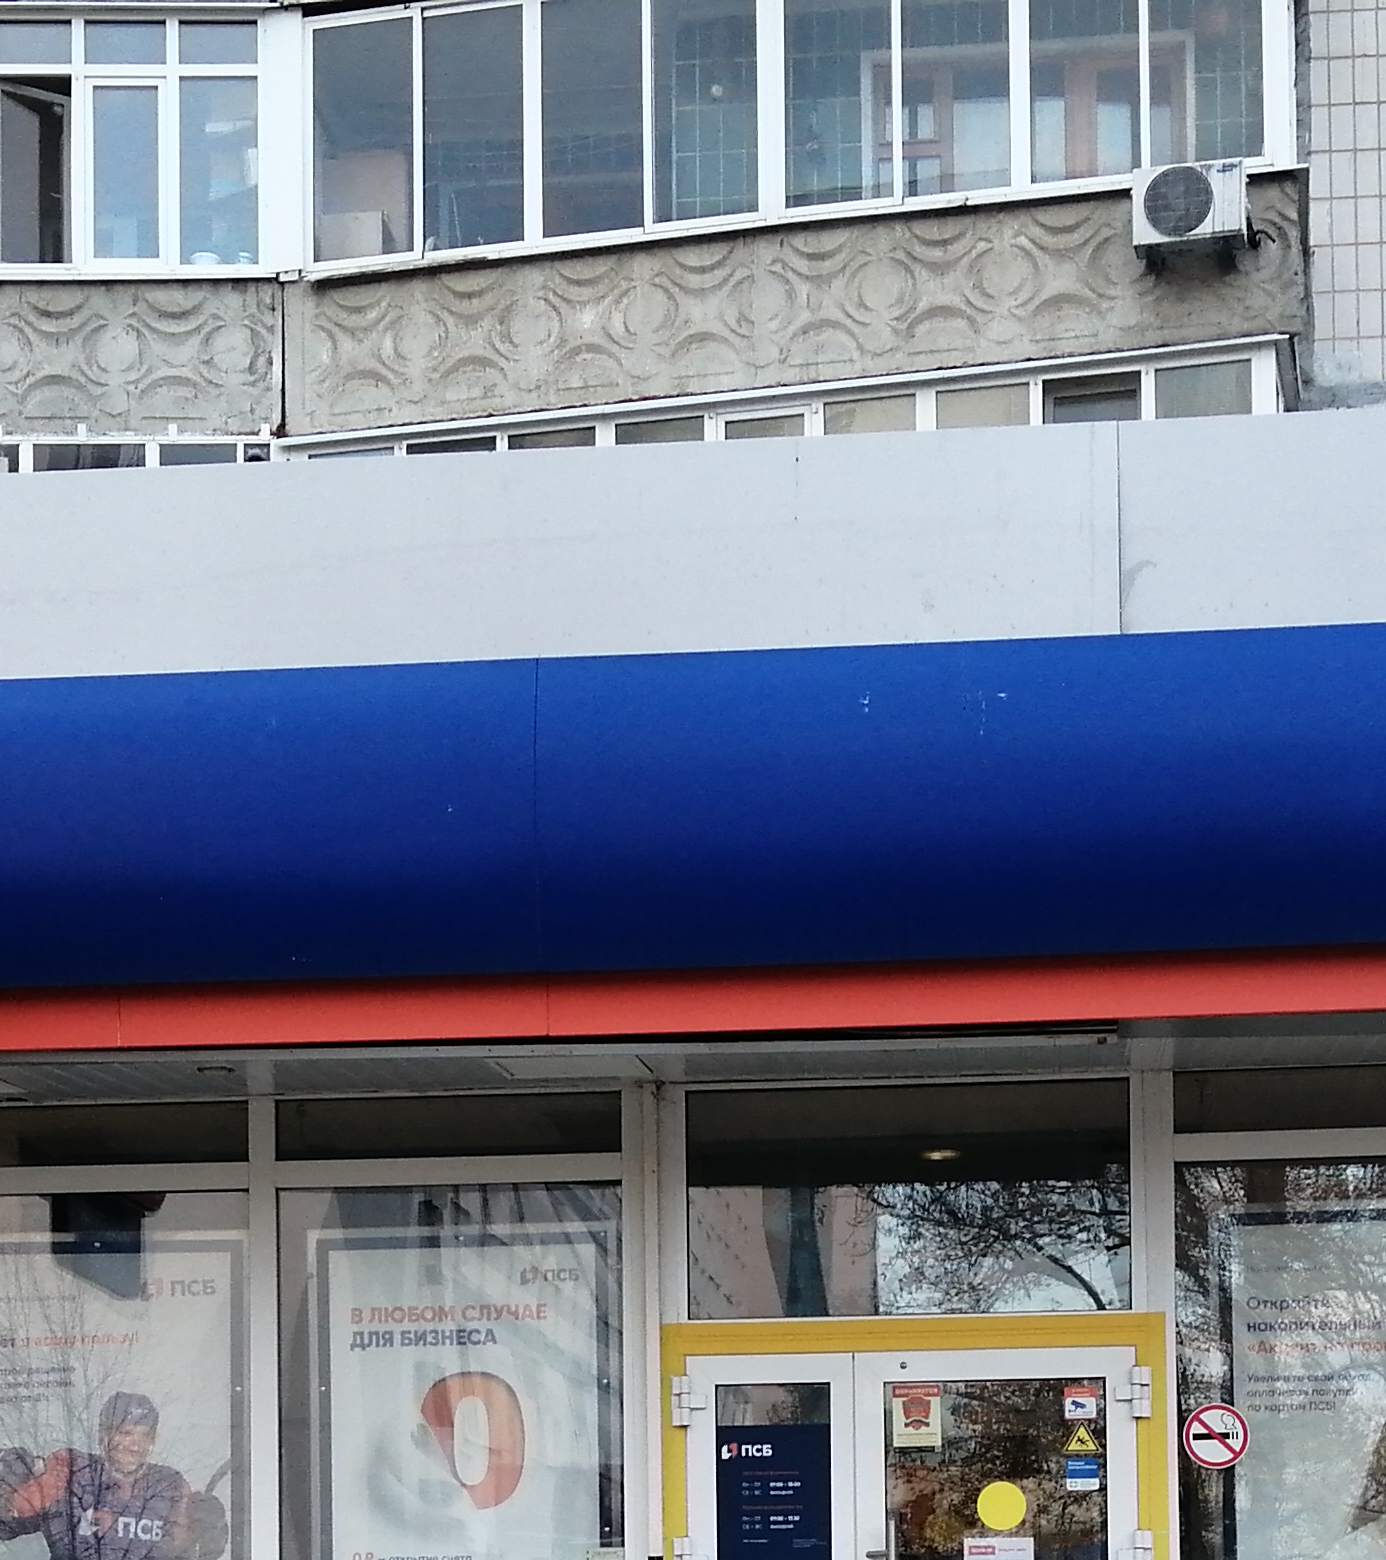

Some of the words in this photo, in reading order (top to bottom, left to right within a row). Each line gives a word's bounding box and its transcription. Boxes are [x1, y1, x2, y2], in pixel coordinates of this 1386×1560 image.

[544, 1268, 581, 1283] ПСБ
[170, 1278, 217, 1297] ПСБ
[350, 1307, 363, 1325] В
[368, 1305, 456, 1324] ЛЮБОМ
[461, 1303, 548, 1322] СЛУЧАЕ
[1247, 1318, 1383, 1334] накопительный
[350, 1331, 394, 1351] ДЛЯ
[400, 1328, 498, 1348] БИЗНЕСА
[1247, 1403, 1261, 1412] по
[741, 1444, 773, 1457] ПСБ
[117, 1516, 164, 1542] ПСБ
